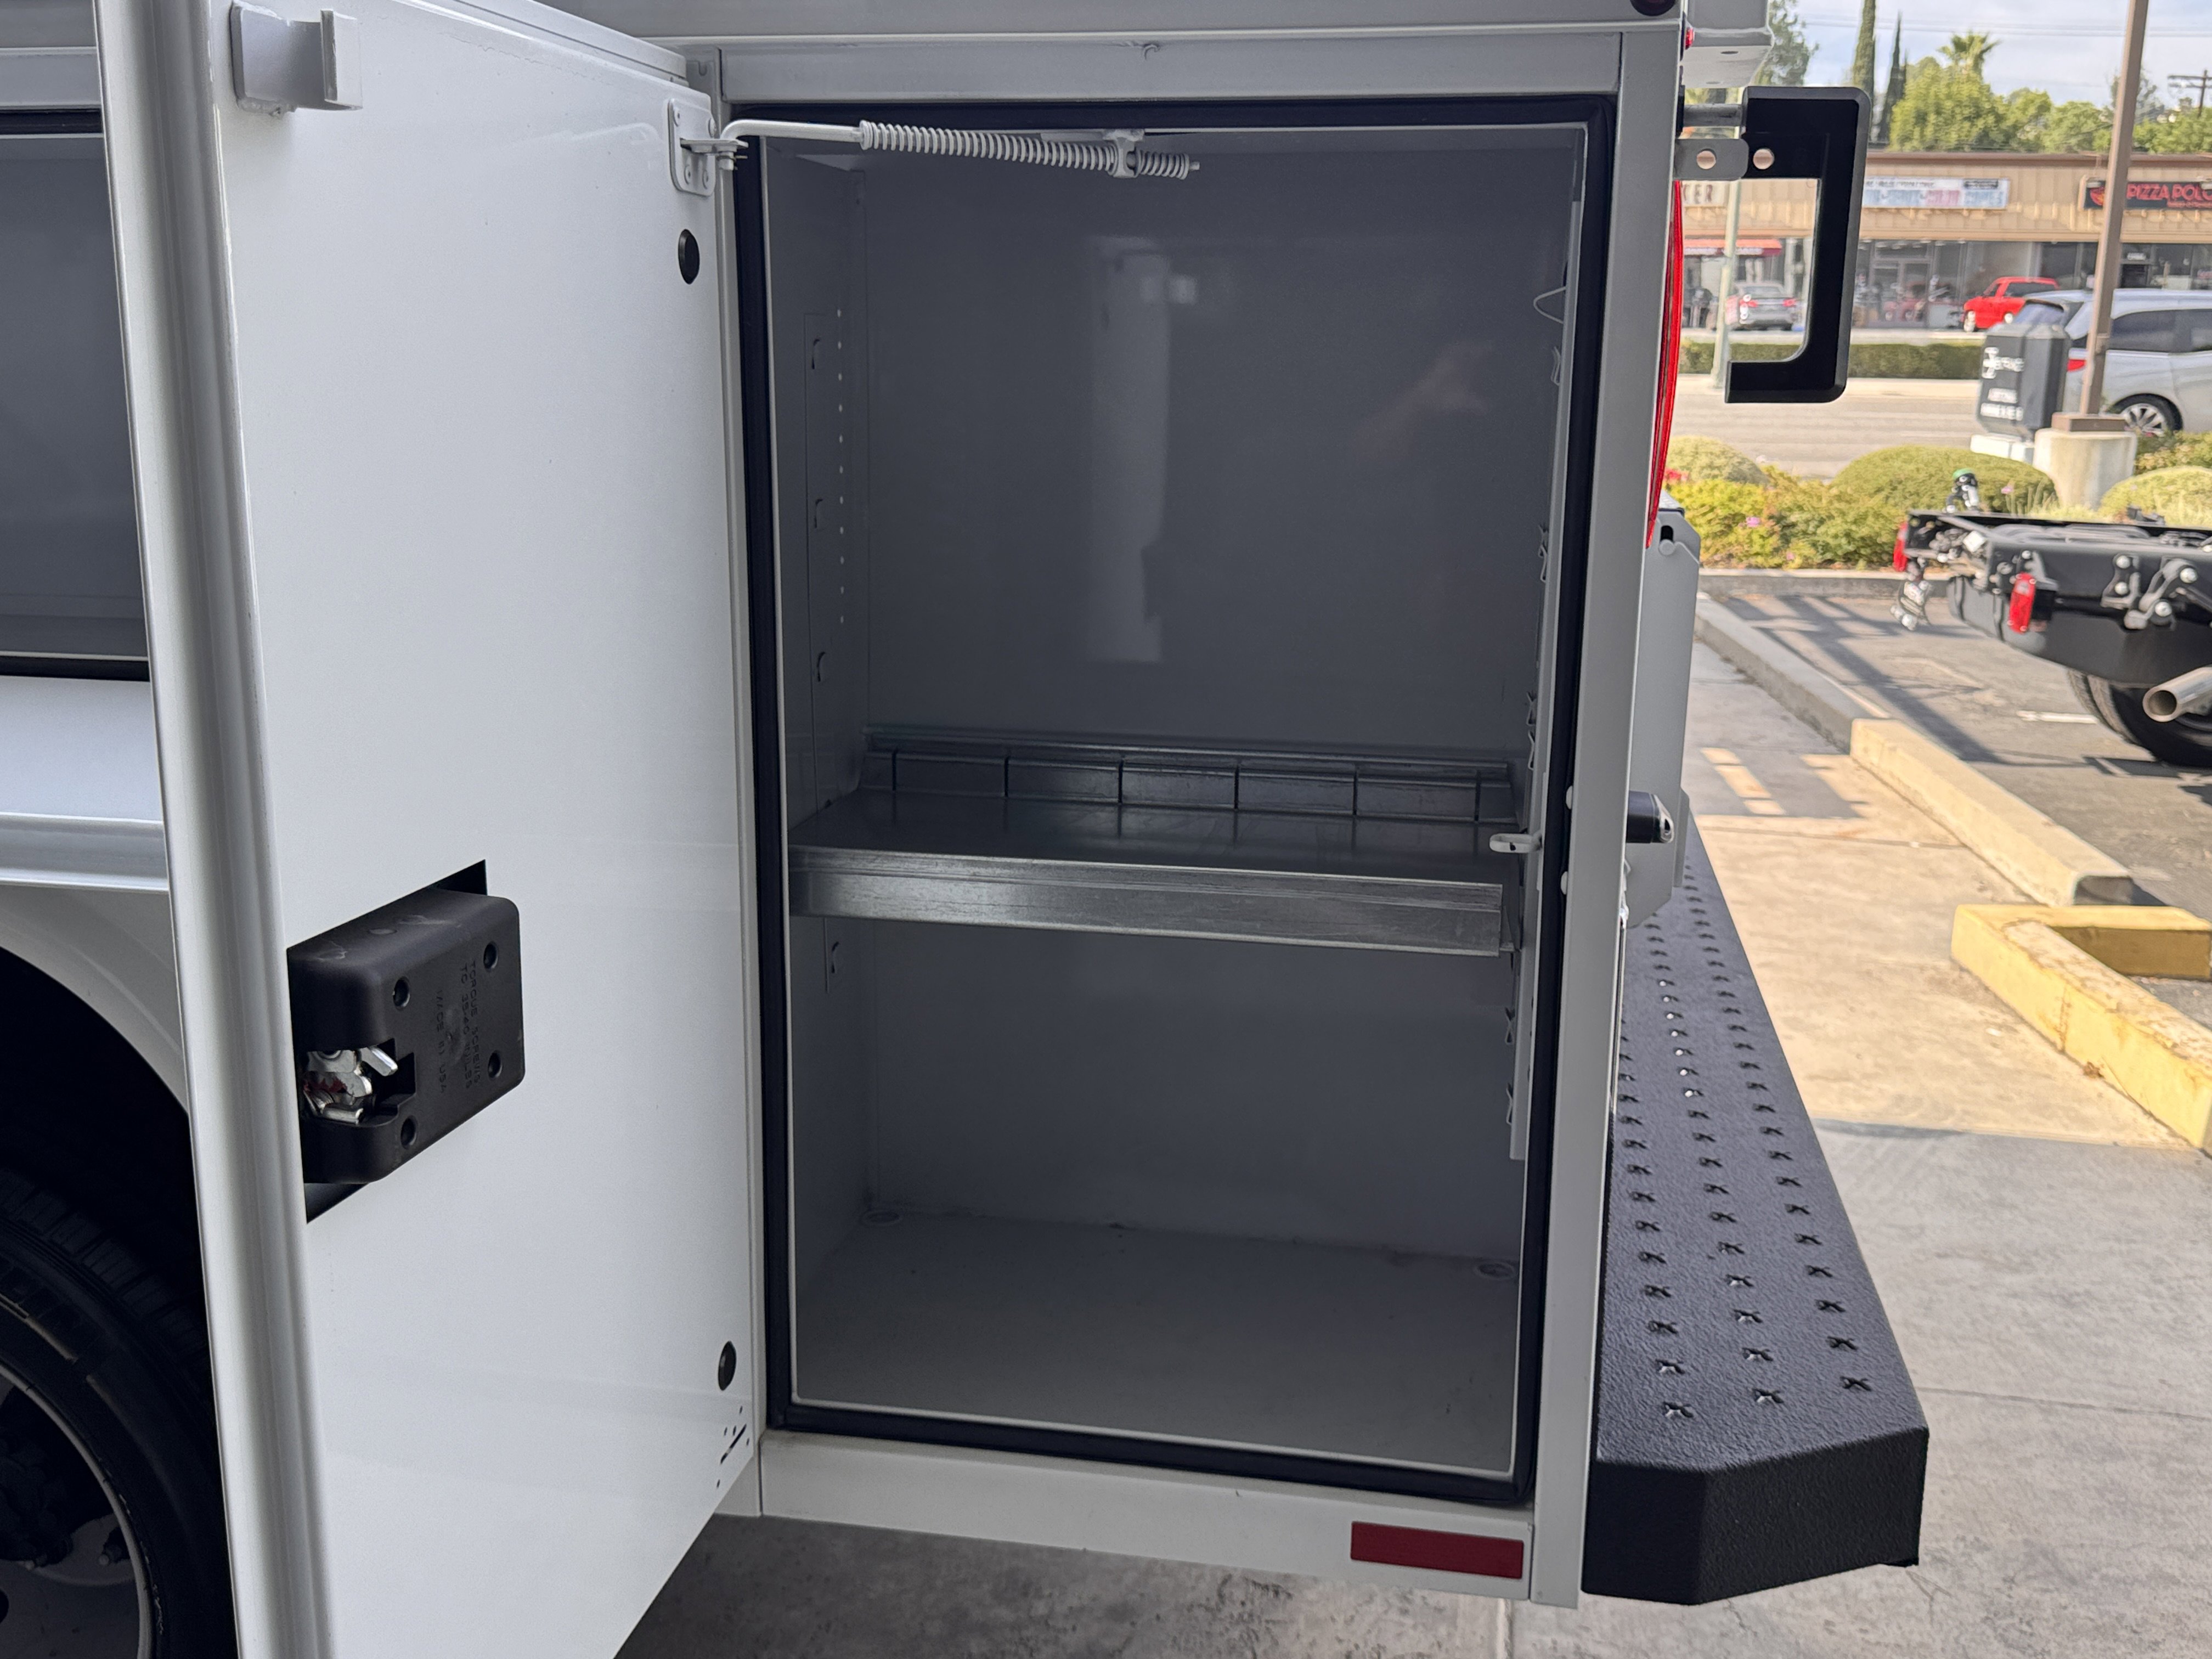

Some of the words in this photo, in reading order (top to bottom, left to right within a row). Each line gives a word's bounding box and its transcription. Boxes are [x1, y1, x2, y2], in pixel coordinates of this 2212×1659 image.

[2126, 184, 2169, 200] PIZZA
[460, 962, 468, 984] TO
[470, 960, 478, 1017] TORQUE
[439, 1063, 447, 1094] USA
